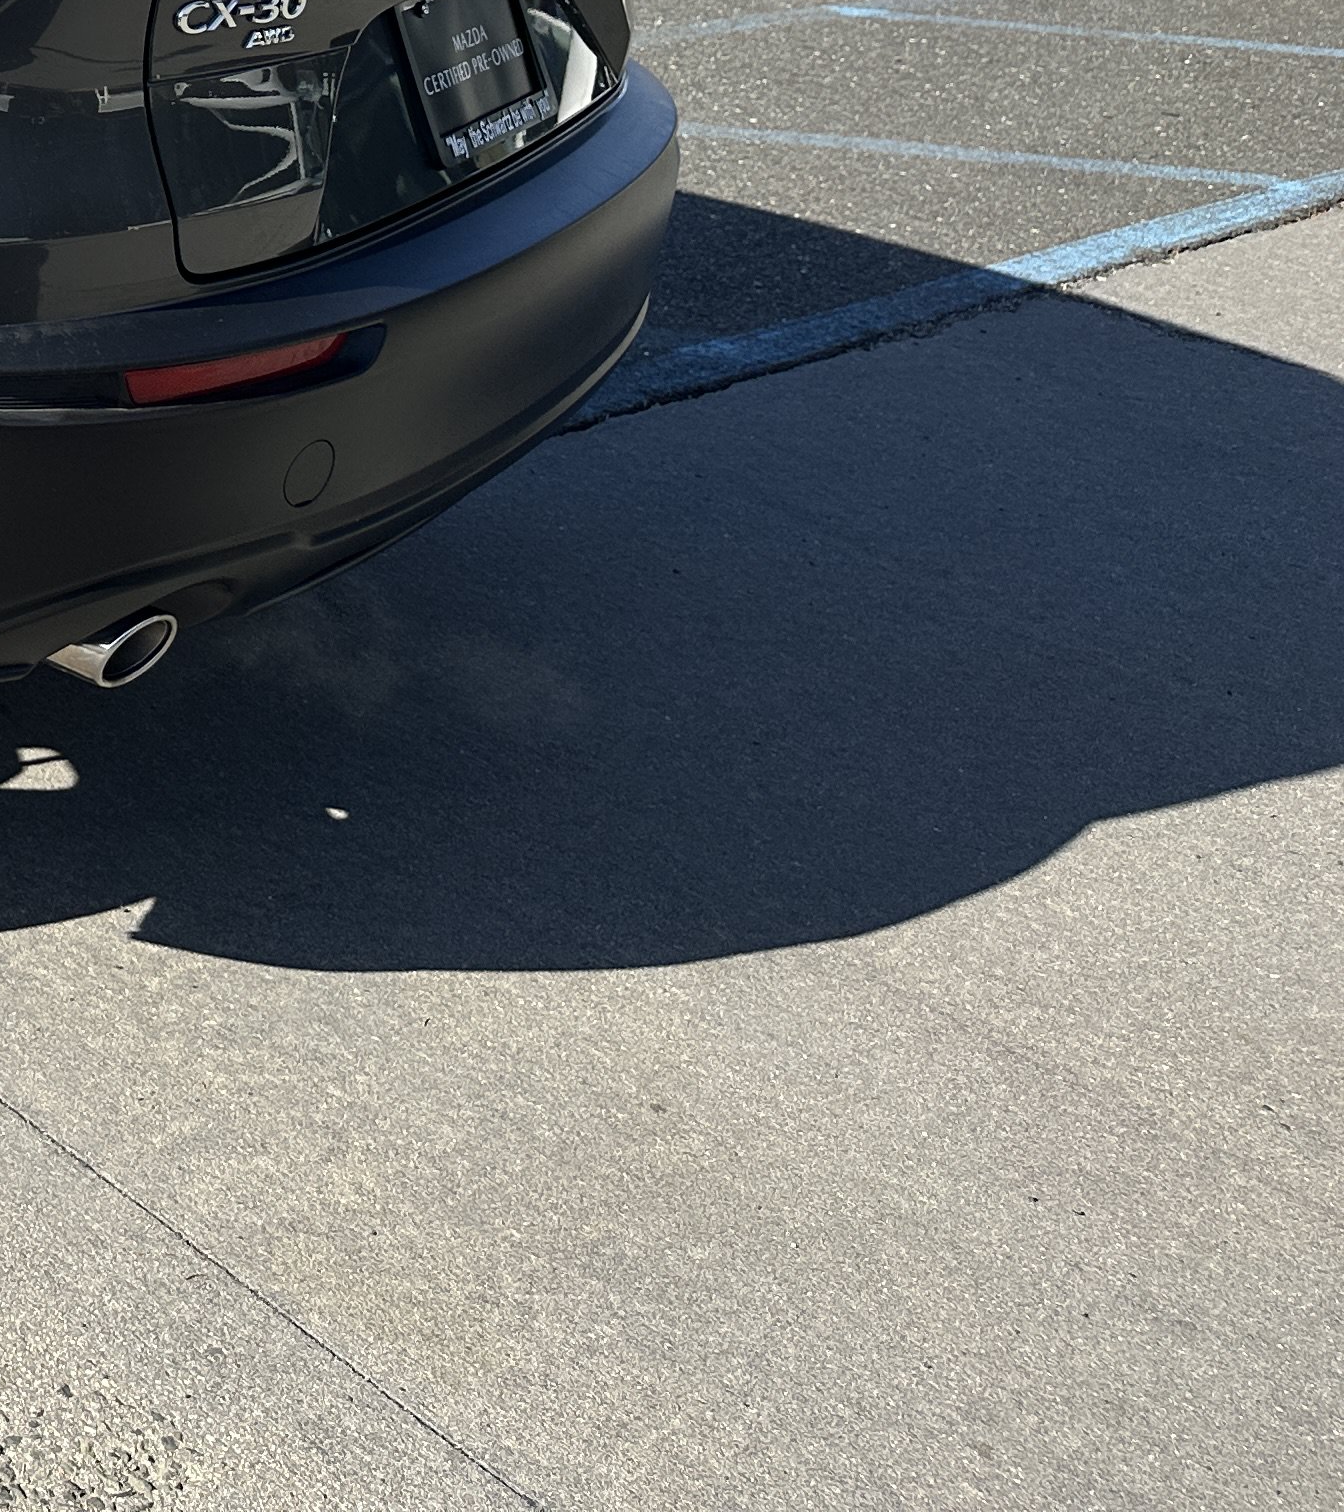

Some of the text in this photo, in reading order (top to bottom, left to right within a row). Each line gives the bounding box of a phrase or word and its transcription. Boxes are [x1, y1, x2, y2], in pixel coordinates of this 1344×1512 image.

[243, 25, 296, 49] AWD
[451, 25, 489, 53] MAZDA
[423, 38, 524, 96] CERTIFIED PRE-OWNED
[468, 126, 484, 148] the
[480, 110, 514, 142] Schwartz
[509, 107, 523, 127] be
